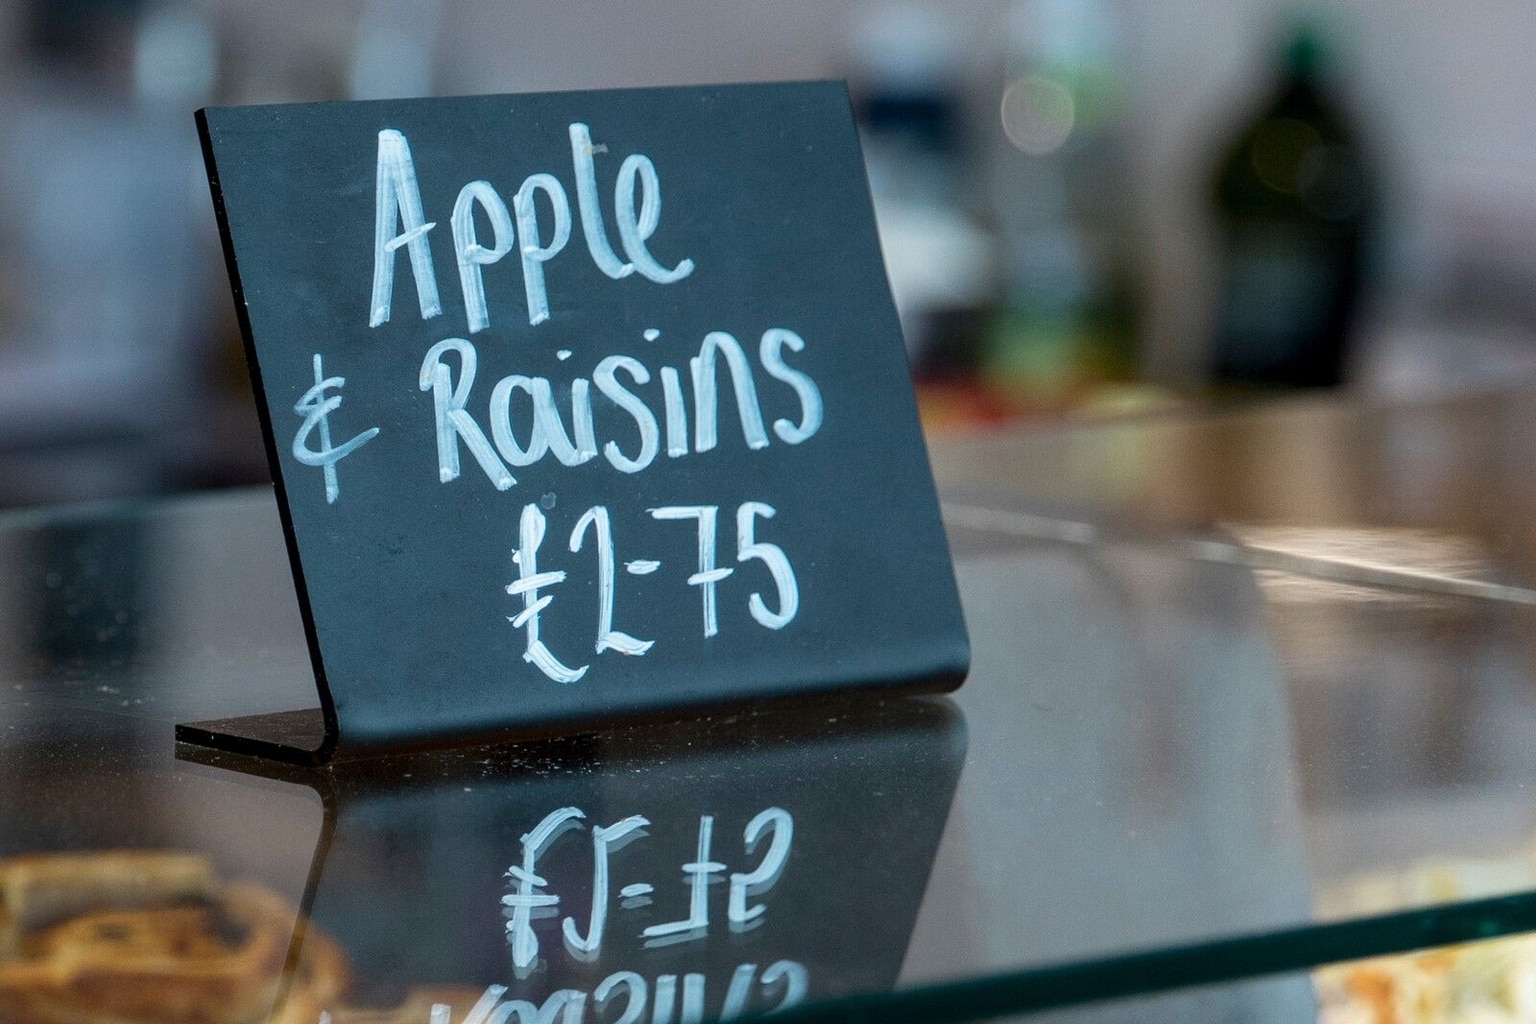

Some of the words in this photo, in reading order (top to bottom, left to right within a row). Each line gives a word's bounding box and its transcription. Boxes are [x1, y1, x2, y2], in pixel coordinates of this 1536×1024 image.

[369, 122, 694, 334] Apple
[293, 353, 380, 504] &
[419, 327, 823, 491] Raisins
[505, 502, 800, 683] £2-75
